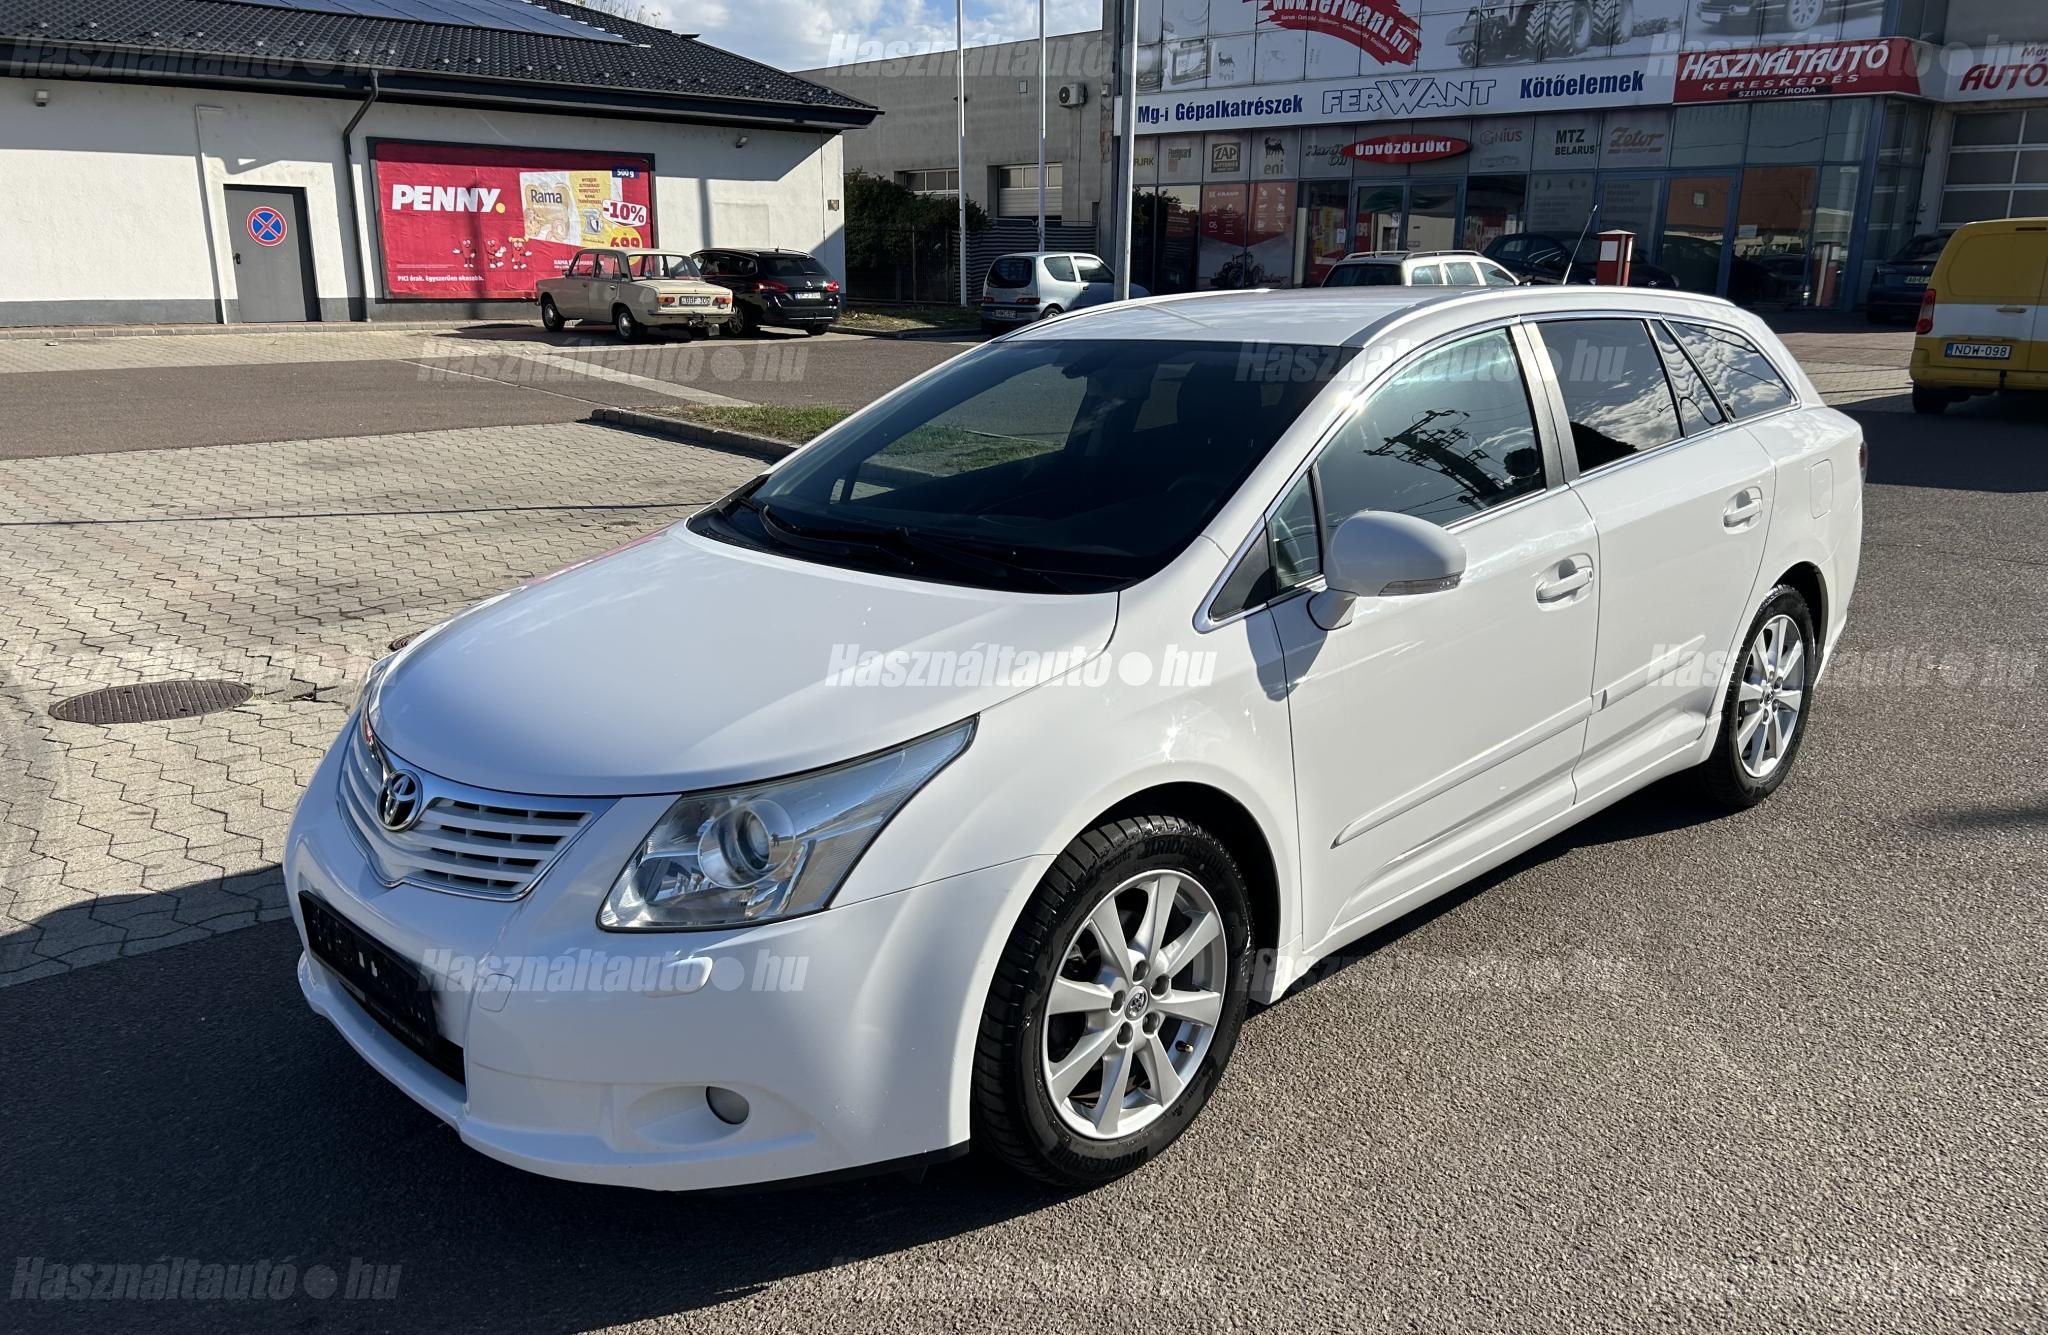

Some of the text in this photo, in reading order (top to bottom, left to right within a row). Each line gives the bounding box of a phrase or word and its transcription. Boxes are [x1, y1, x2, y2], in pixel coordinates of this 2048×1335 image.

[1679, 40, 1889, 81] HASZNÁLTAUTÓ
[1702, 73, 1859, 91] KERESKEDÉS
[1959, 57, 2048, 91] AUTÓ
[1520, 70, 1645, 99] Kötőelemek
[1321, 77, 1497, 115] FERWANT
[1137, 94, 1303, 125] Mg-i Gépalkatrészek
[1555, 128, 1585, 144] MTZ
[1215, 146, 1237, 161] ZAP
[1354, 140, 1452, 157] ÜDVÖZÖLJÜK!
[1554, 145, 1595, 156] BELARUS
[1263, 159, 1284, 175] eni
[530, 189, 563, 204] Rama
[602, 201, 645, 224] -10%
[1954, 344, 2007, 358] NDW-098
